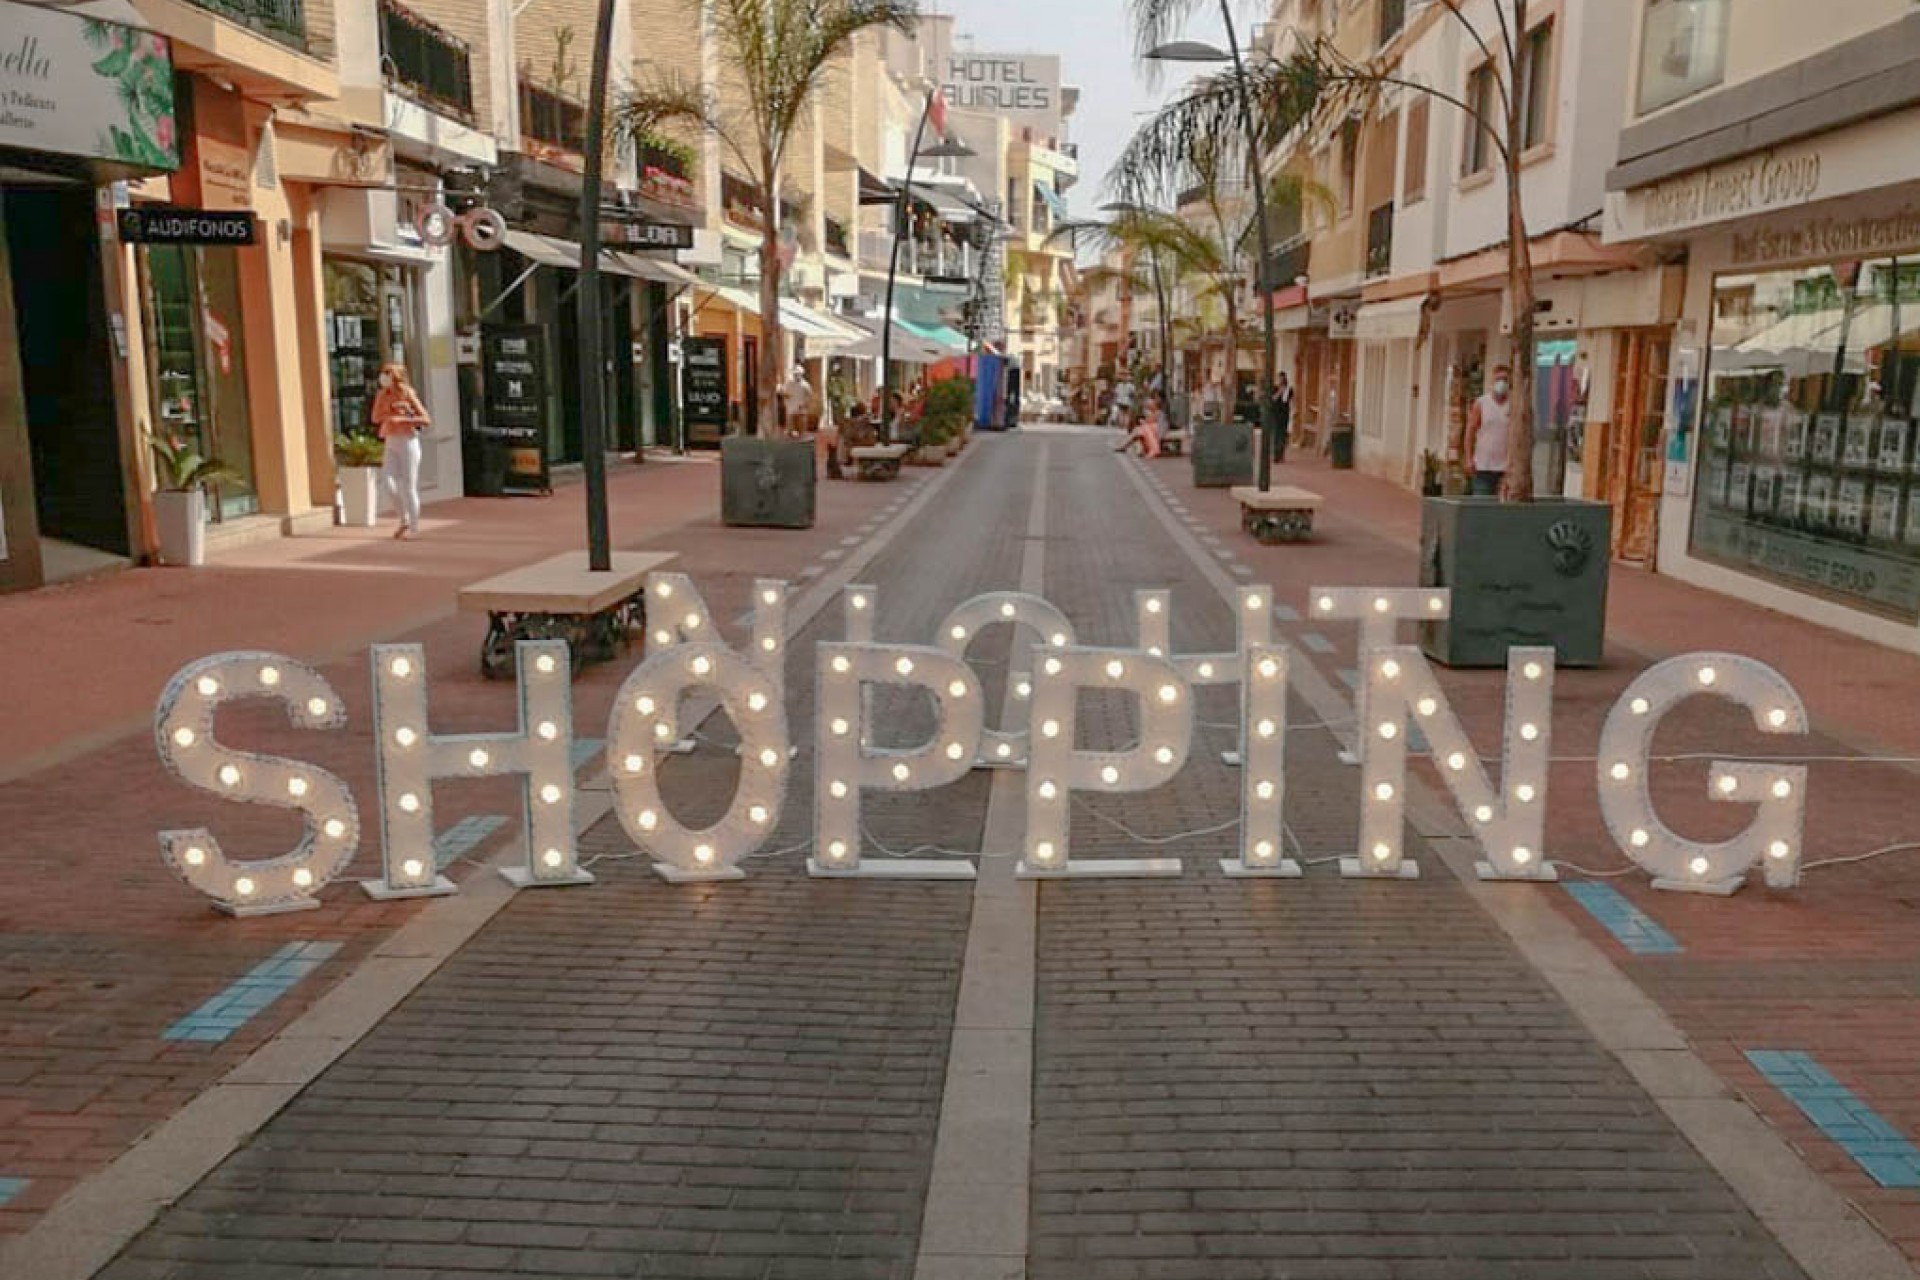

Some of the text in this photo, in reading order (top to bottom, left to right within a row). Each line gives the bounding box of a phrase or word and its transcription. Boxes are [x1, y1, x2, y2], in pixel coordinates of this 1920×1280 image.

[949, 59, 1037, 83] HOTEL
[1759, 149, 1821, 205] Group
[148, 217, 247, 238] AUDIFONOS
[155, 639, 1808, 907] SHOPPING
